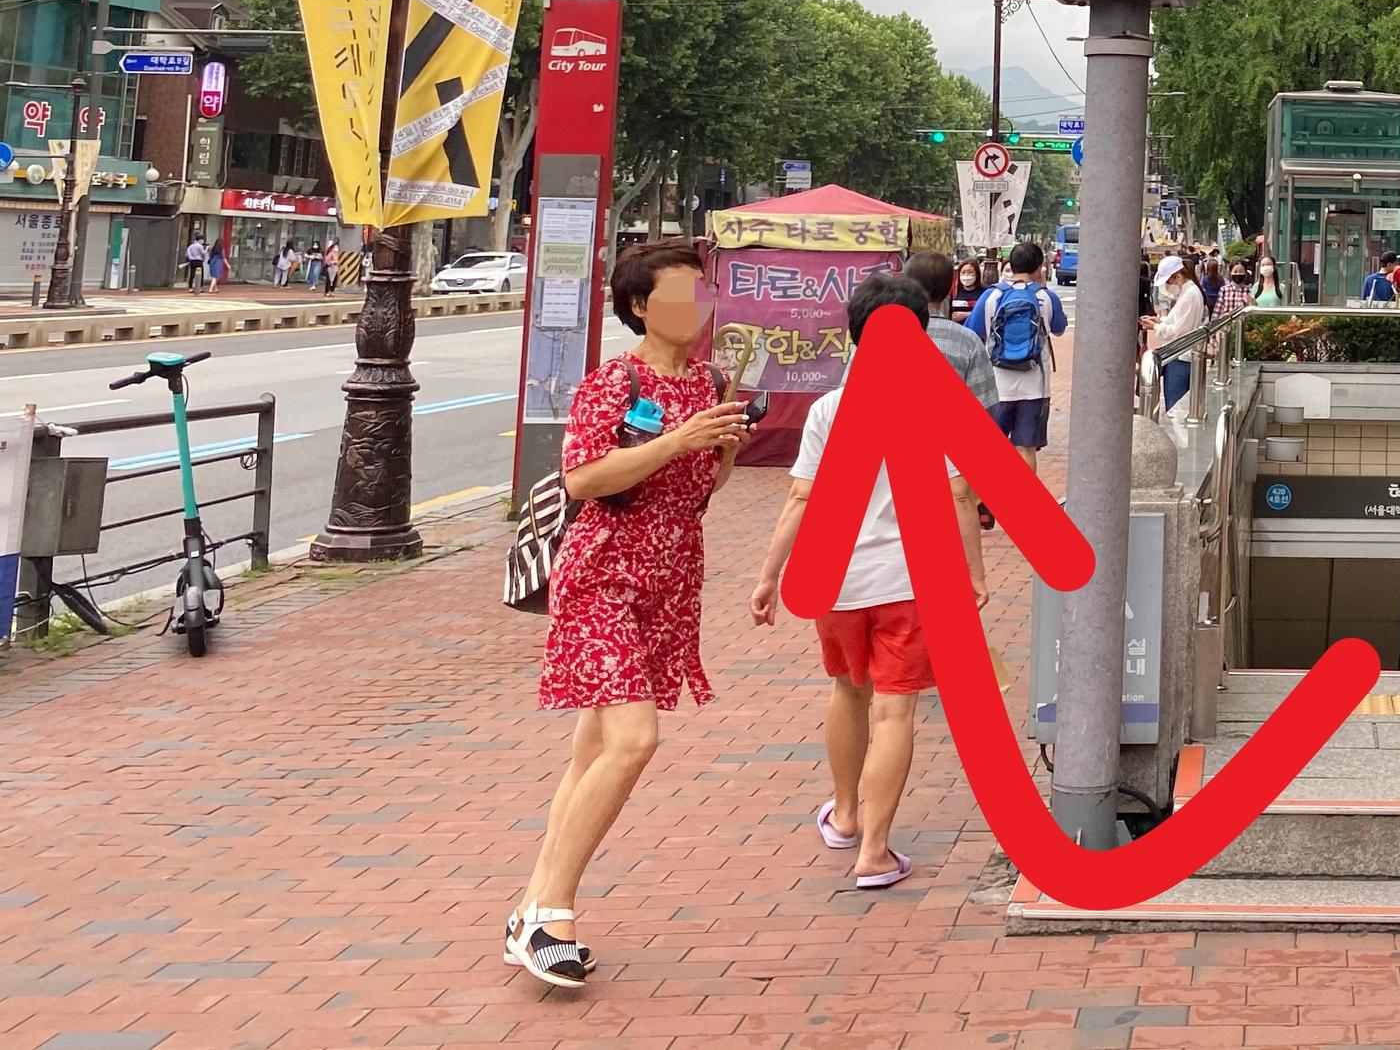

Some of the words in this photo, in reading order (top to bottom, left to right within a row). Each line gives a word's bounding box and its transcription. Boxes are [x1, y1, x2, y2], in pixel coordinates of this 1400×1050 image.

[548, 60, 575, 73] City
[577, 60, 607, 71] Tour
[203, 96, 220, 112] 약
[23, 100, 51, 138] 약
[720, 217, 775, 242] 사주
[785, 219, 839, 244] 타로
[847, 220, 904, 246] 궁합
